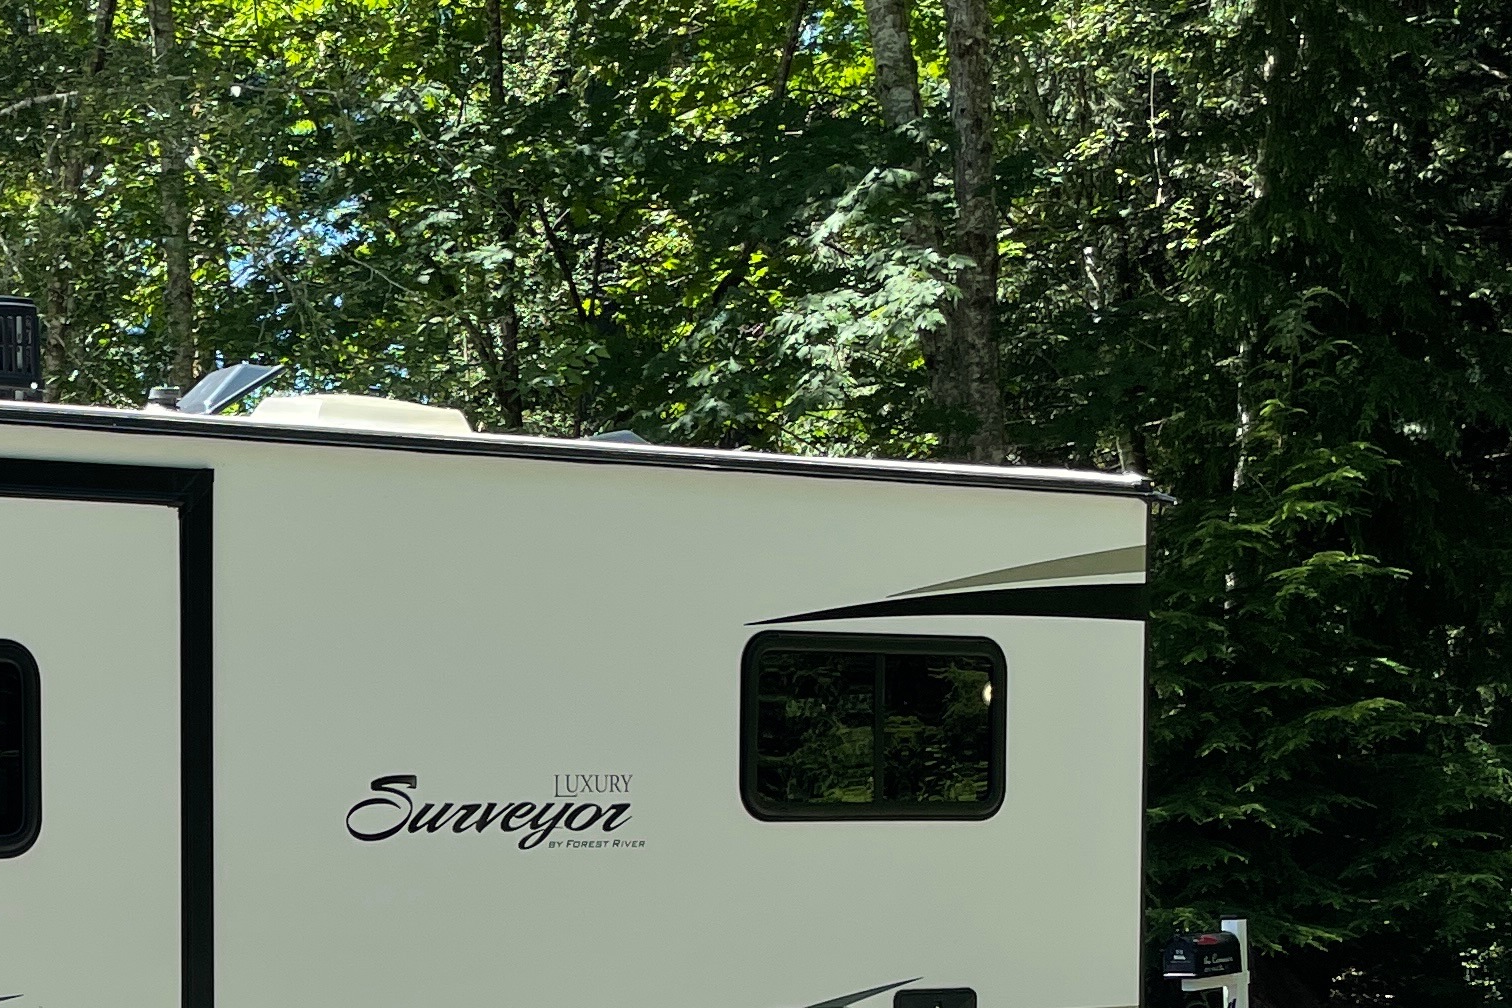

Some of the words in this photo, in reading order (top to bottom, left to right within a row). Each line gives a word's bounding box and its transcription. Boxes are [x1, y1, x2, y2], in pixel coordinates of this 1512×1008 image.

[553, 773, 634, 798] LUXURY
[345, 774, 633, 850] Surveyor
[548, 841, 564, 849] BY
[565, 839, 610, 849] FOREST
[612, 839, 646, 848] RIVER
